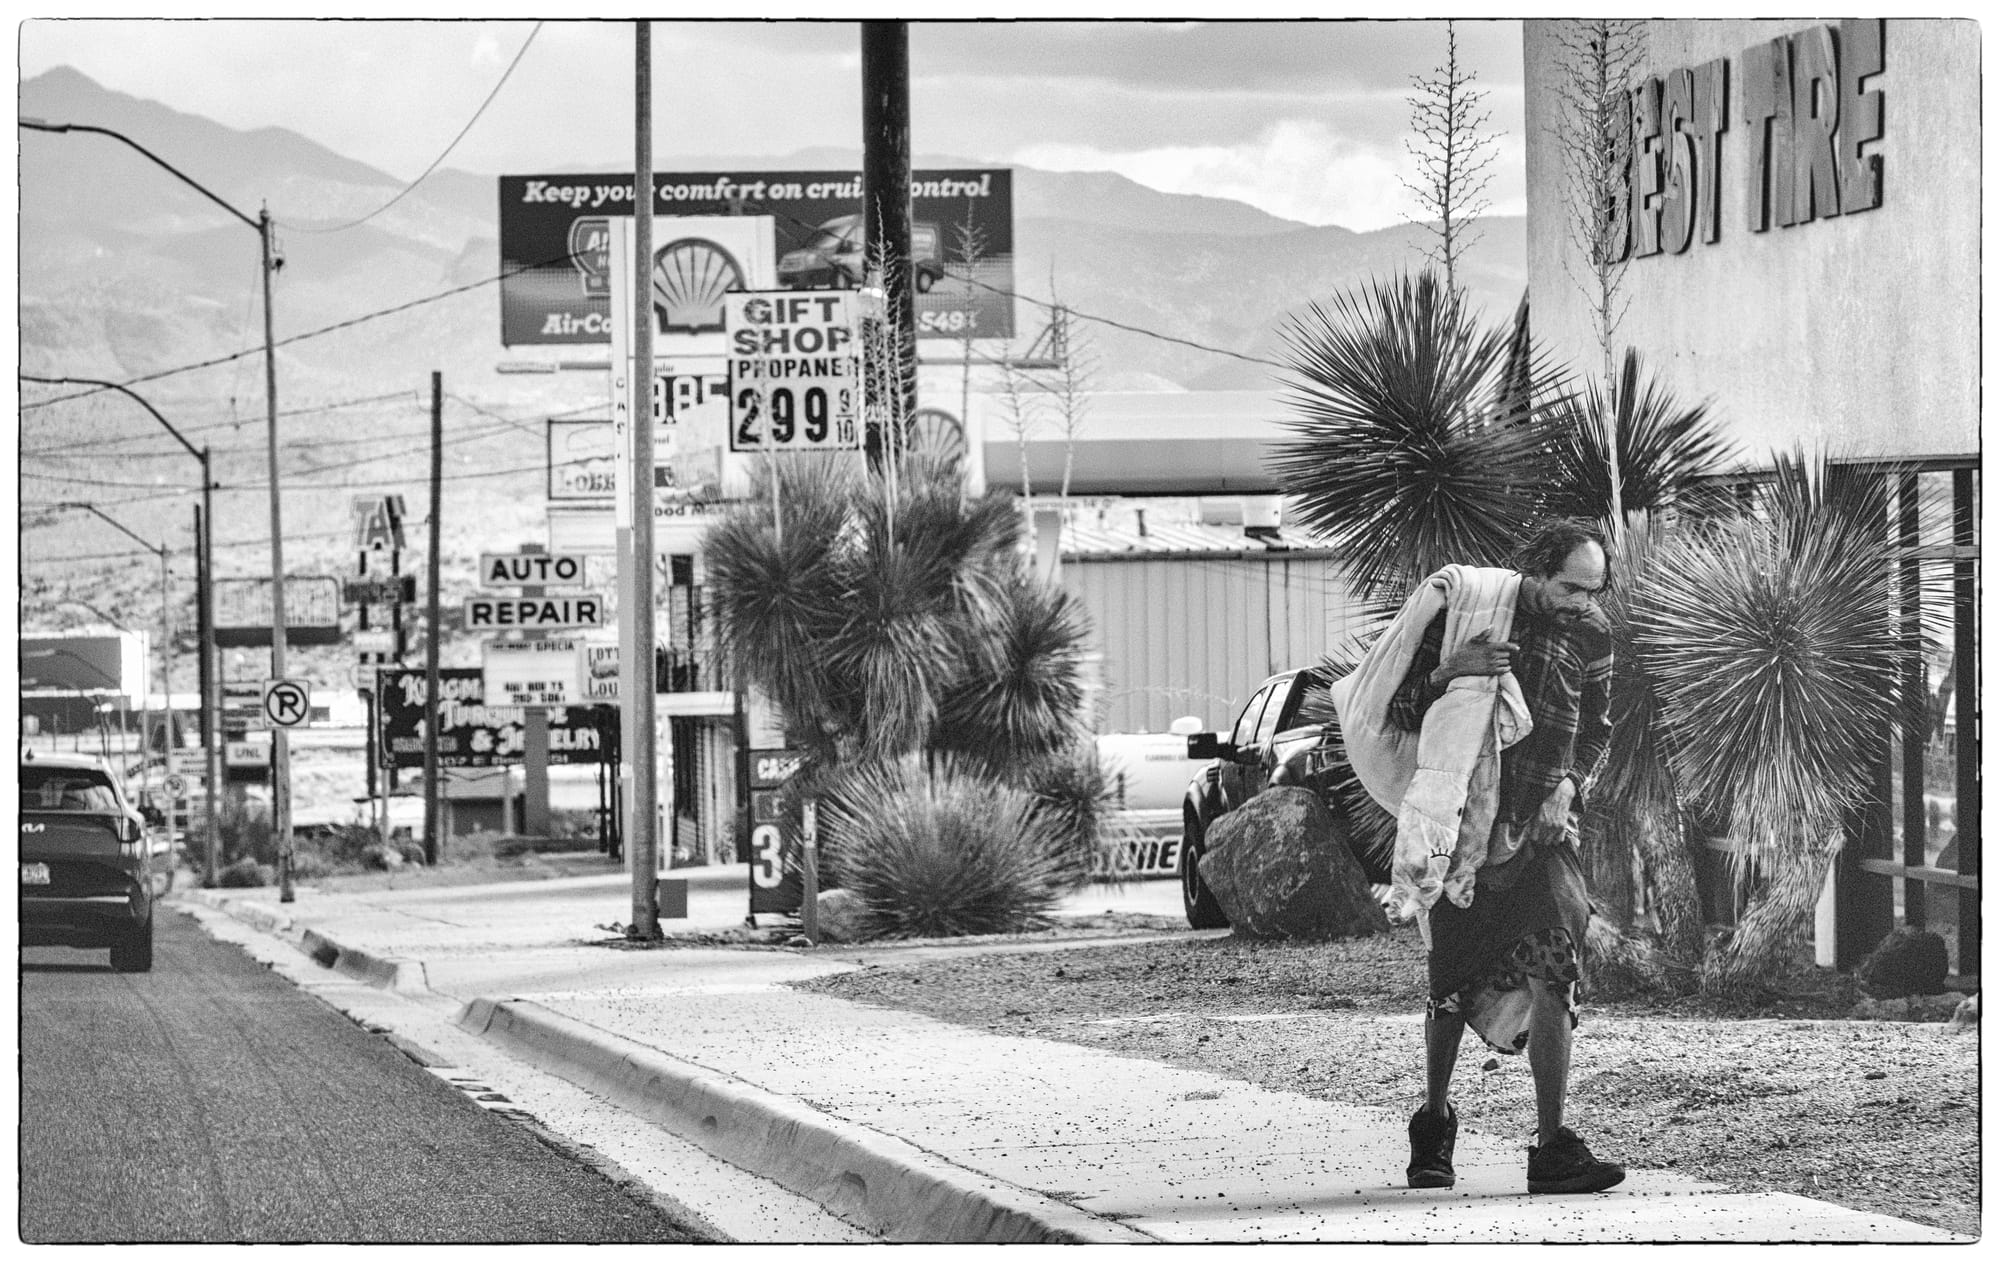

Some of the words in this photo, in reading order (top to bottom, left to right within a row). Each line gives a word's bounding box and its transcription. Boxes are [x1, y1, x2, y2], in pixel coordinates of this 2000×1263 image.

[1594, 56, 1729, 265] BEST
[1742, 19, 1886, 234] TIRE
[522, 180, 591, 208] Keep
[591, 184, 656, 208] you
[768, 182, 803, 200] on
[805, 176, 864, 199] crui
[911, 173, 992, 198] ontrol
[541, 312, 613, 336] AirCo
[744, 297, 840, 324] GIFT
[734, 327, 851, 355] SHOP
[737, 387, 828, 444] 299
[654, 504, 685, 517] ood
[490, 558, 578, 581] AUTO
[472, 601, 597, 626] REPAIR
[470, 729, 494, 752] &
[752, 824, 783, 889] 3
